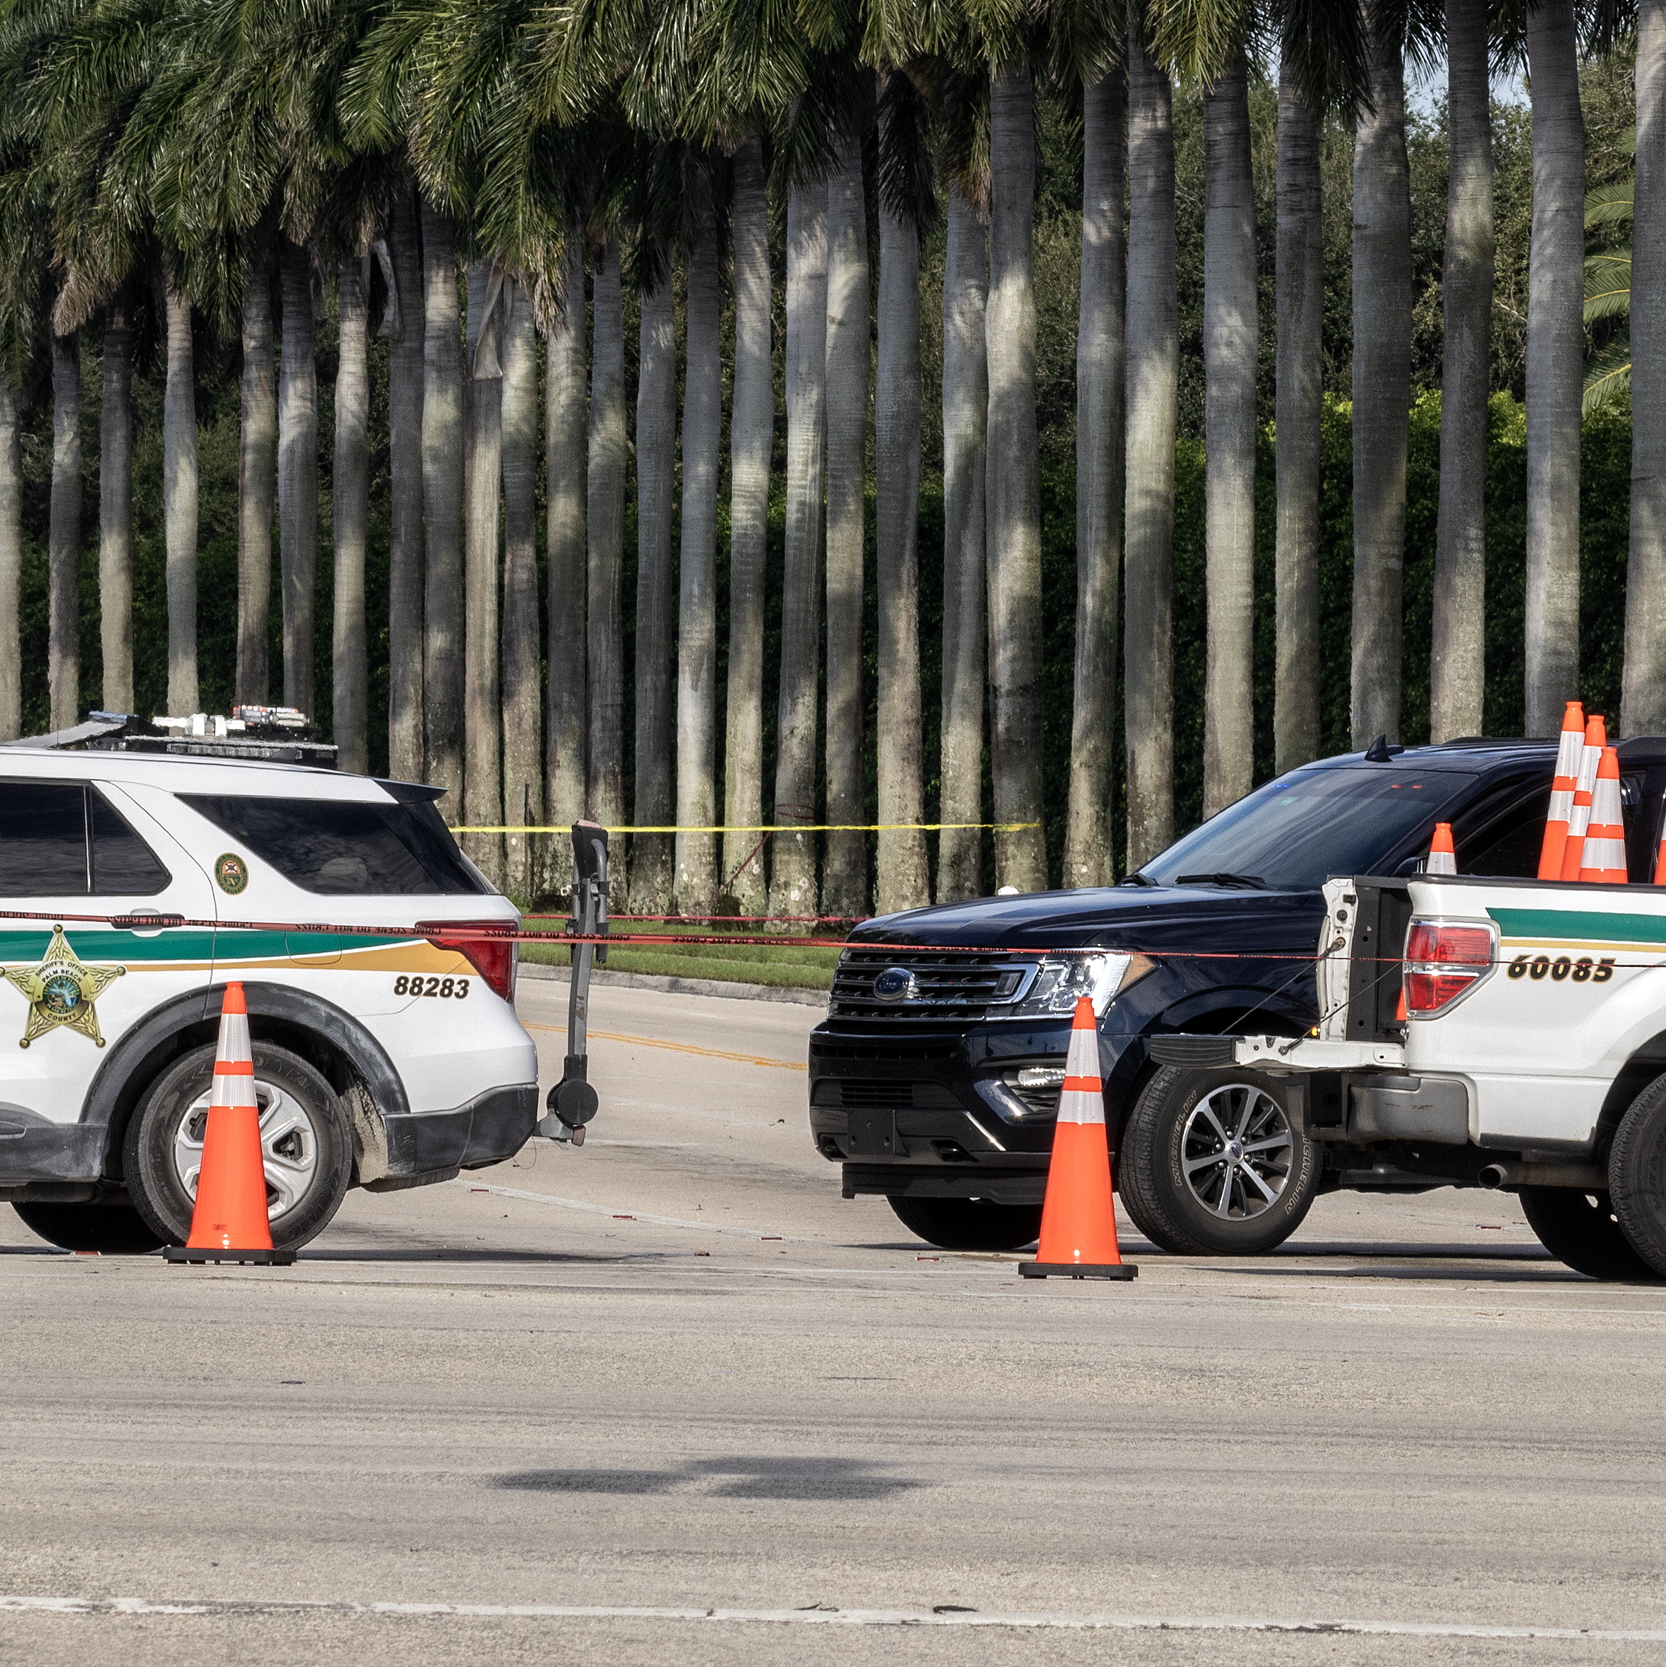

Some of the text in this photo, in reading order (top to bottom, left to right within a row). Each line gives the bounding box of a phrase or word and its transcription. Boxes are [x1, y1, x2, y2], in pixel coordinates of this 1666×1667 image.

[41, 968, 58, 983] PALM
[61, 969, 83, 983] BEACH
[67, 961, 88, 977] OFFICE
[1507, 954, 1617, 983] 60085
[394, 975, 470, 1000] 88283
[47, 1013, 77, 1022] COUNTY
[1169, 1090, 1197, 1187] MICHELIN
[1285, 1132, 1312, 1215] ICHELIN
